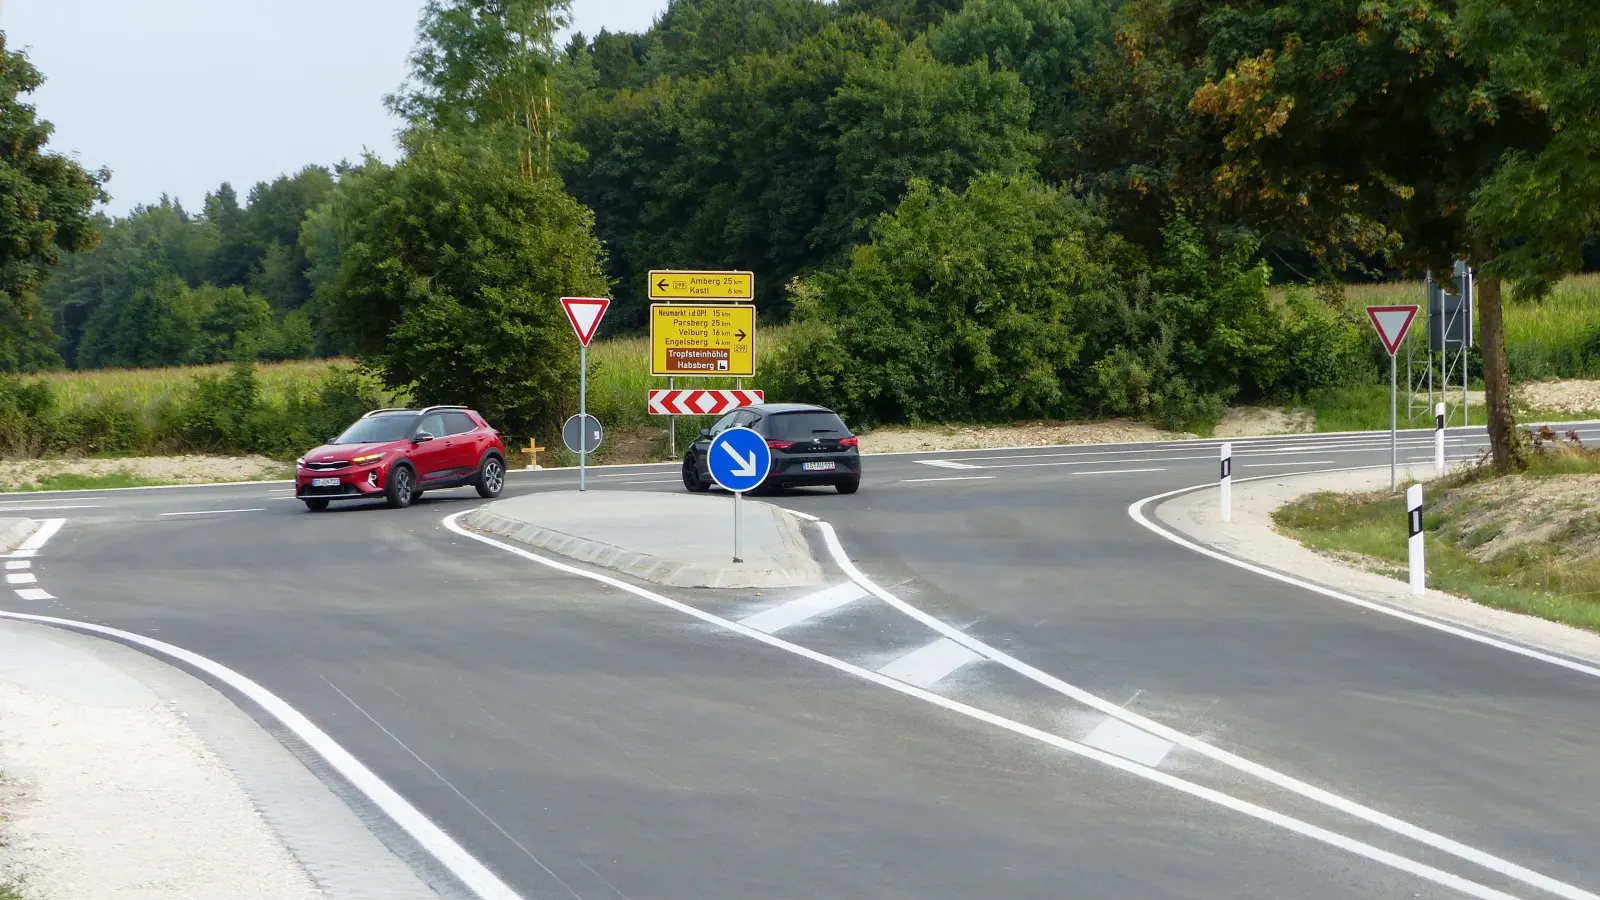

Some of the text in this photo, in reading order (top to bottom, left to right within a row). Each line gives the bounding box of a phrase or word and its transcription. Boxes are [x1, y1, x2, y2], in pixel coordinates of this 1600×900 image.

[690, 278, 720, 286] Amberg
[674, 319, 708, 327] Parsberg
[679, 329, 708, 337] Velburg
[665, 338, 708, 346] Engelsberg
[668, 350, 728, 358] Tropfsteinhöhle
[678, 361, 714, 370] Habsberg
